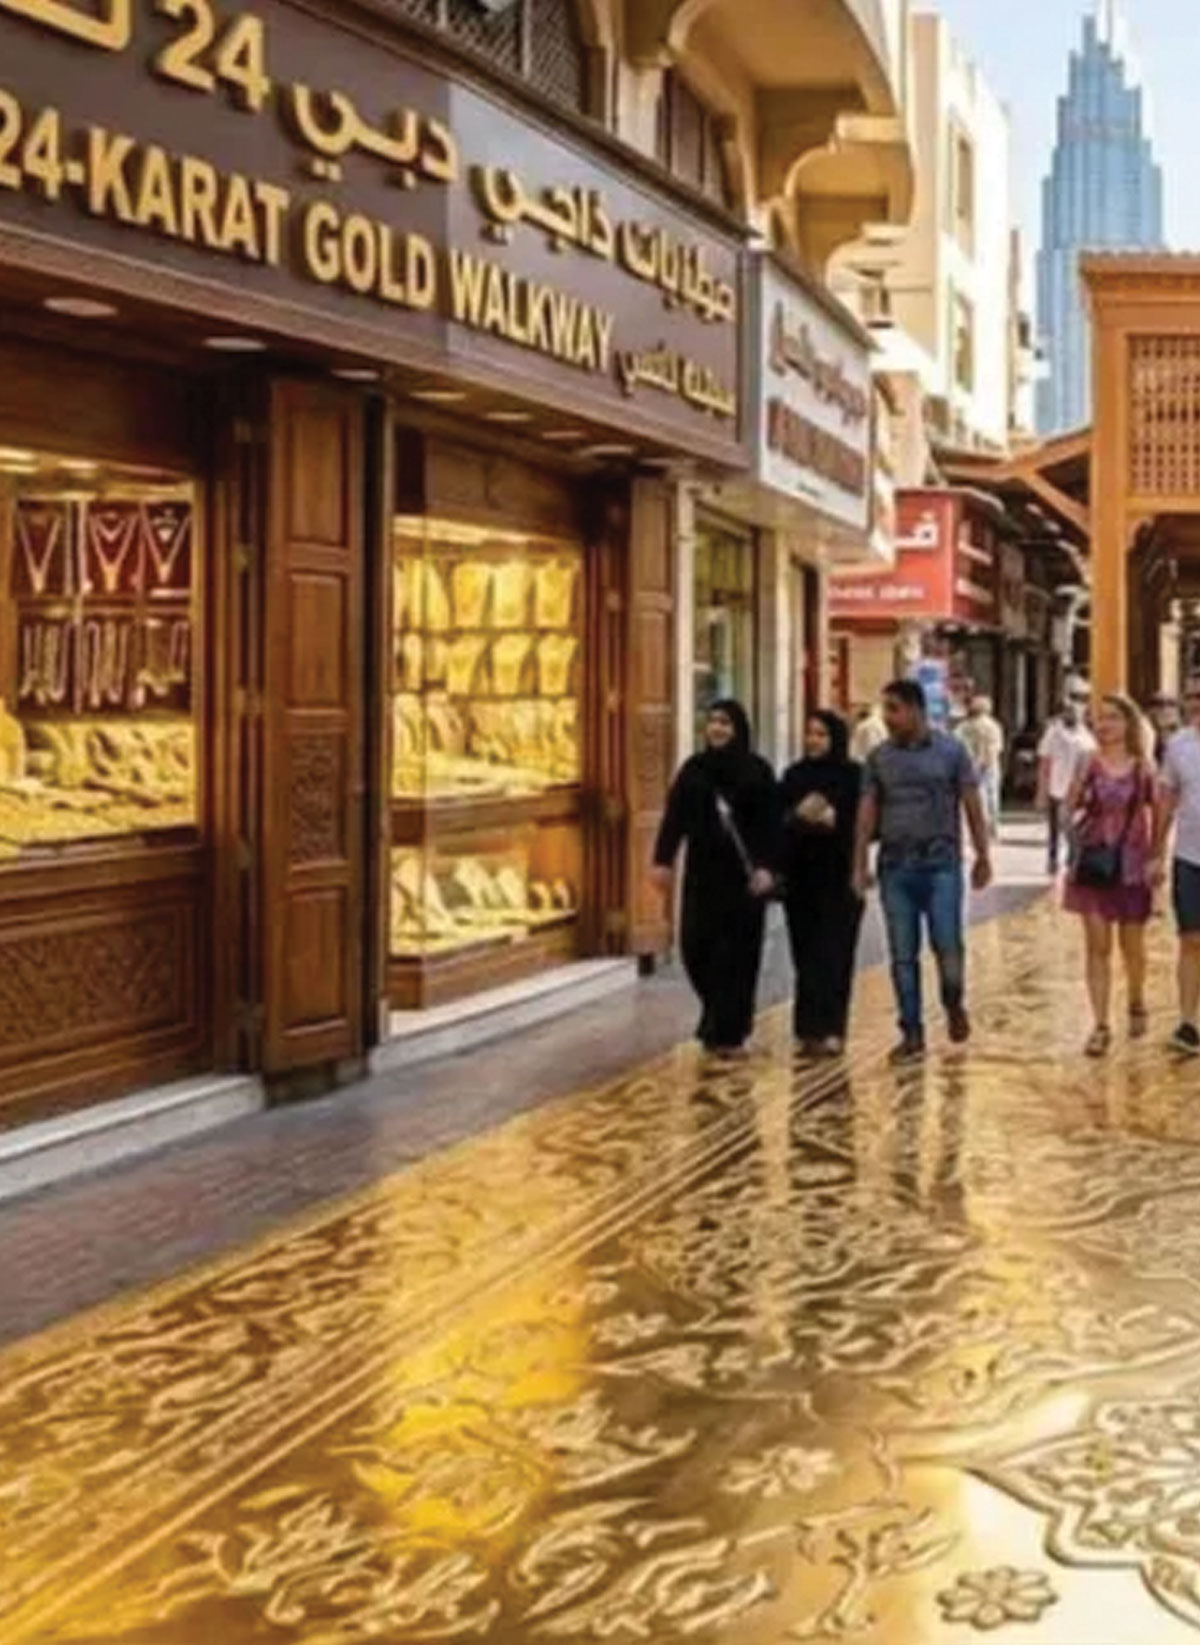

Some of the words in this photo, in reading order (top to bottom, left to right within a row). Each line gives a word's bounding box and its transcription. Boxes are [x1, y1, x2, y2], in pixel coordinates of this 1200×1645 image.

[154, 0, 271, 111] 24
[292, 83, 459, 190] دبي
[305, 202, 436, 309] GOLD
[449, 247, 615, 374] WALKWAY
